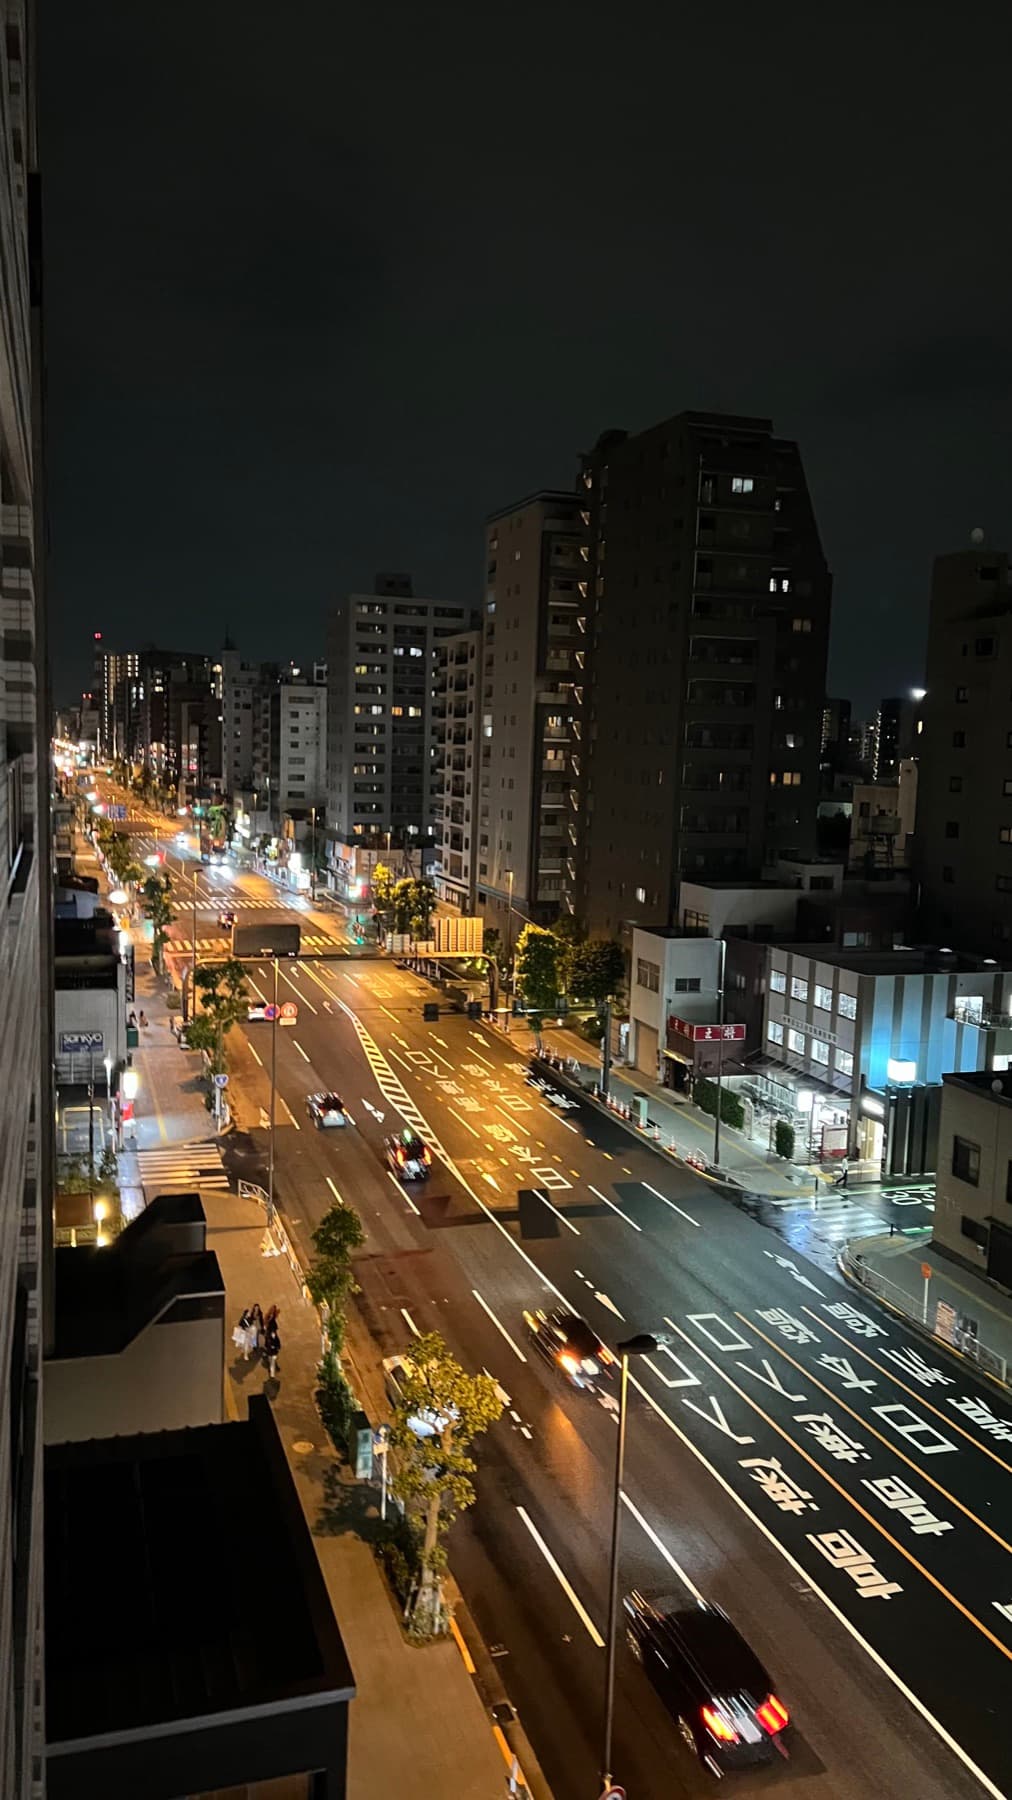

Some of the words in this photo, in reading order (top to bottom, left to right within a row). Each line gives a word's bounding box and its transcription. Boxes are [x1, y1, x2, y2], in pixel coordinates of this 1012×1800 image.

[482, 1123, 574, 1190] 日本橋
[880, 1191, 922, 1205] 30
[686, 1313, 955, 1537] 高速入口
[754, 1307, 960, 1455] 日本橋
[821, 1301, 1012, 1443] 清洲橋
[640, 1344, 904, 1601] 高速入口
